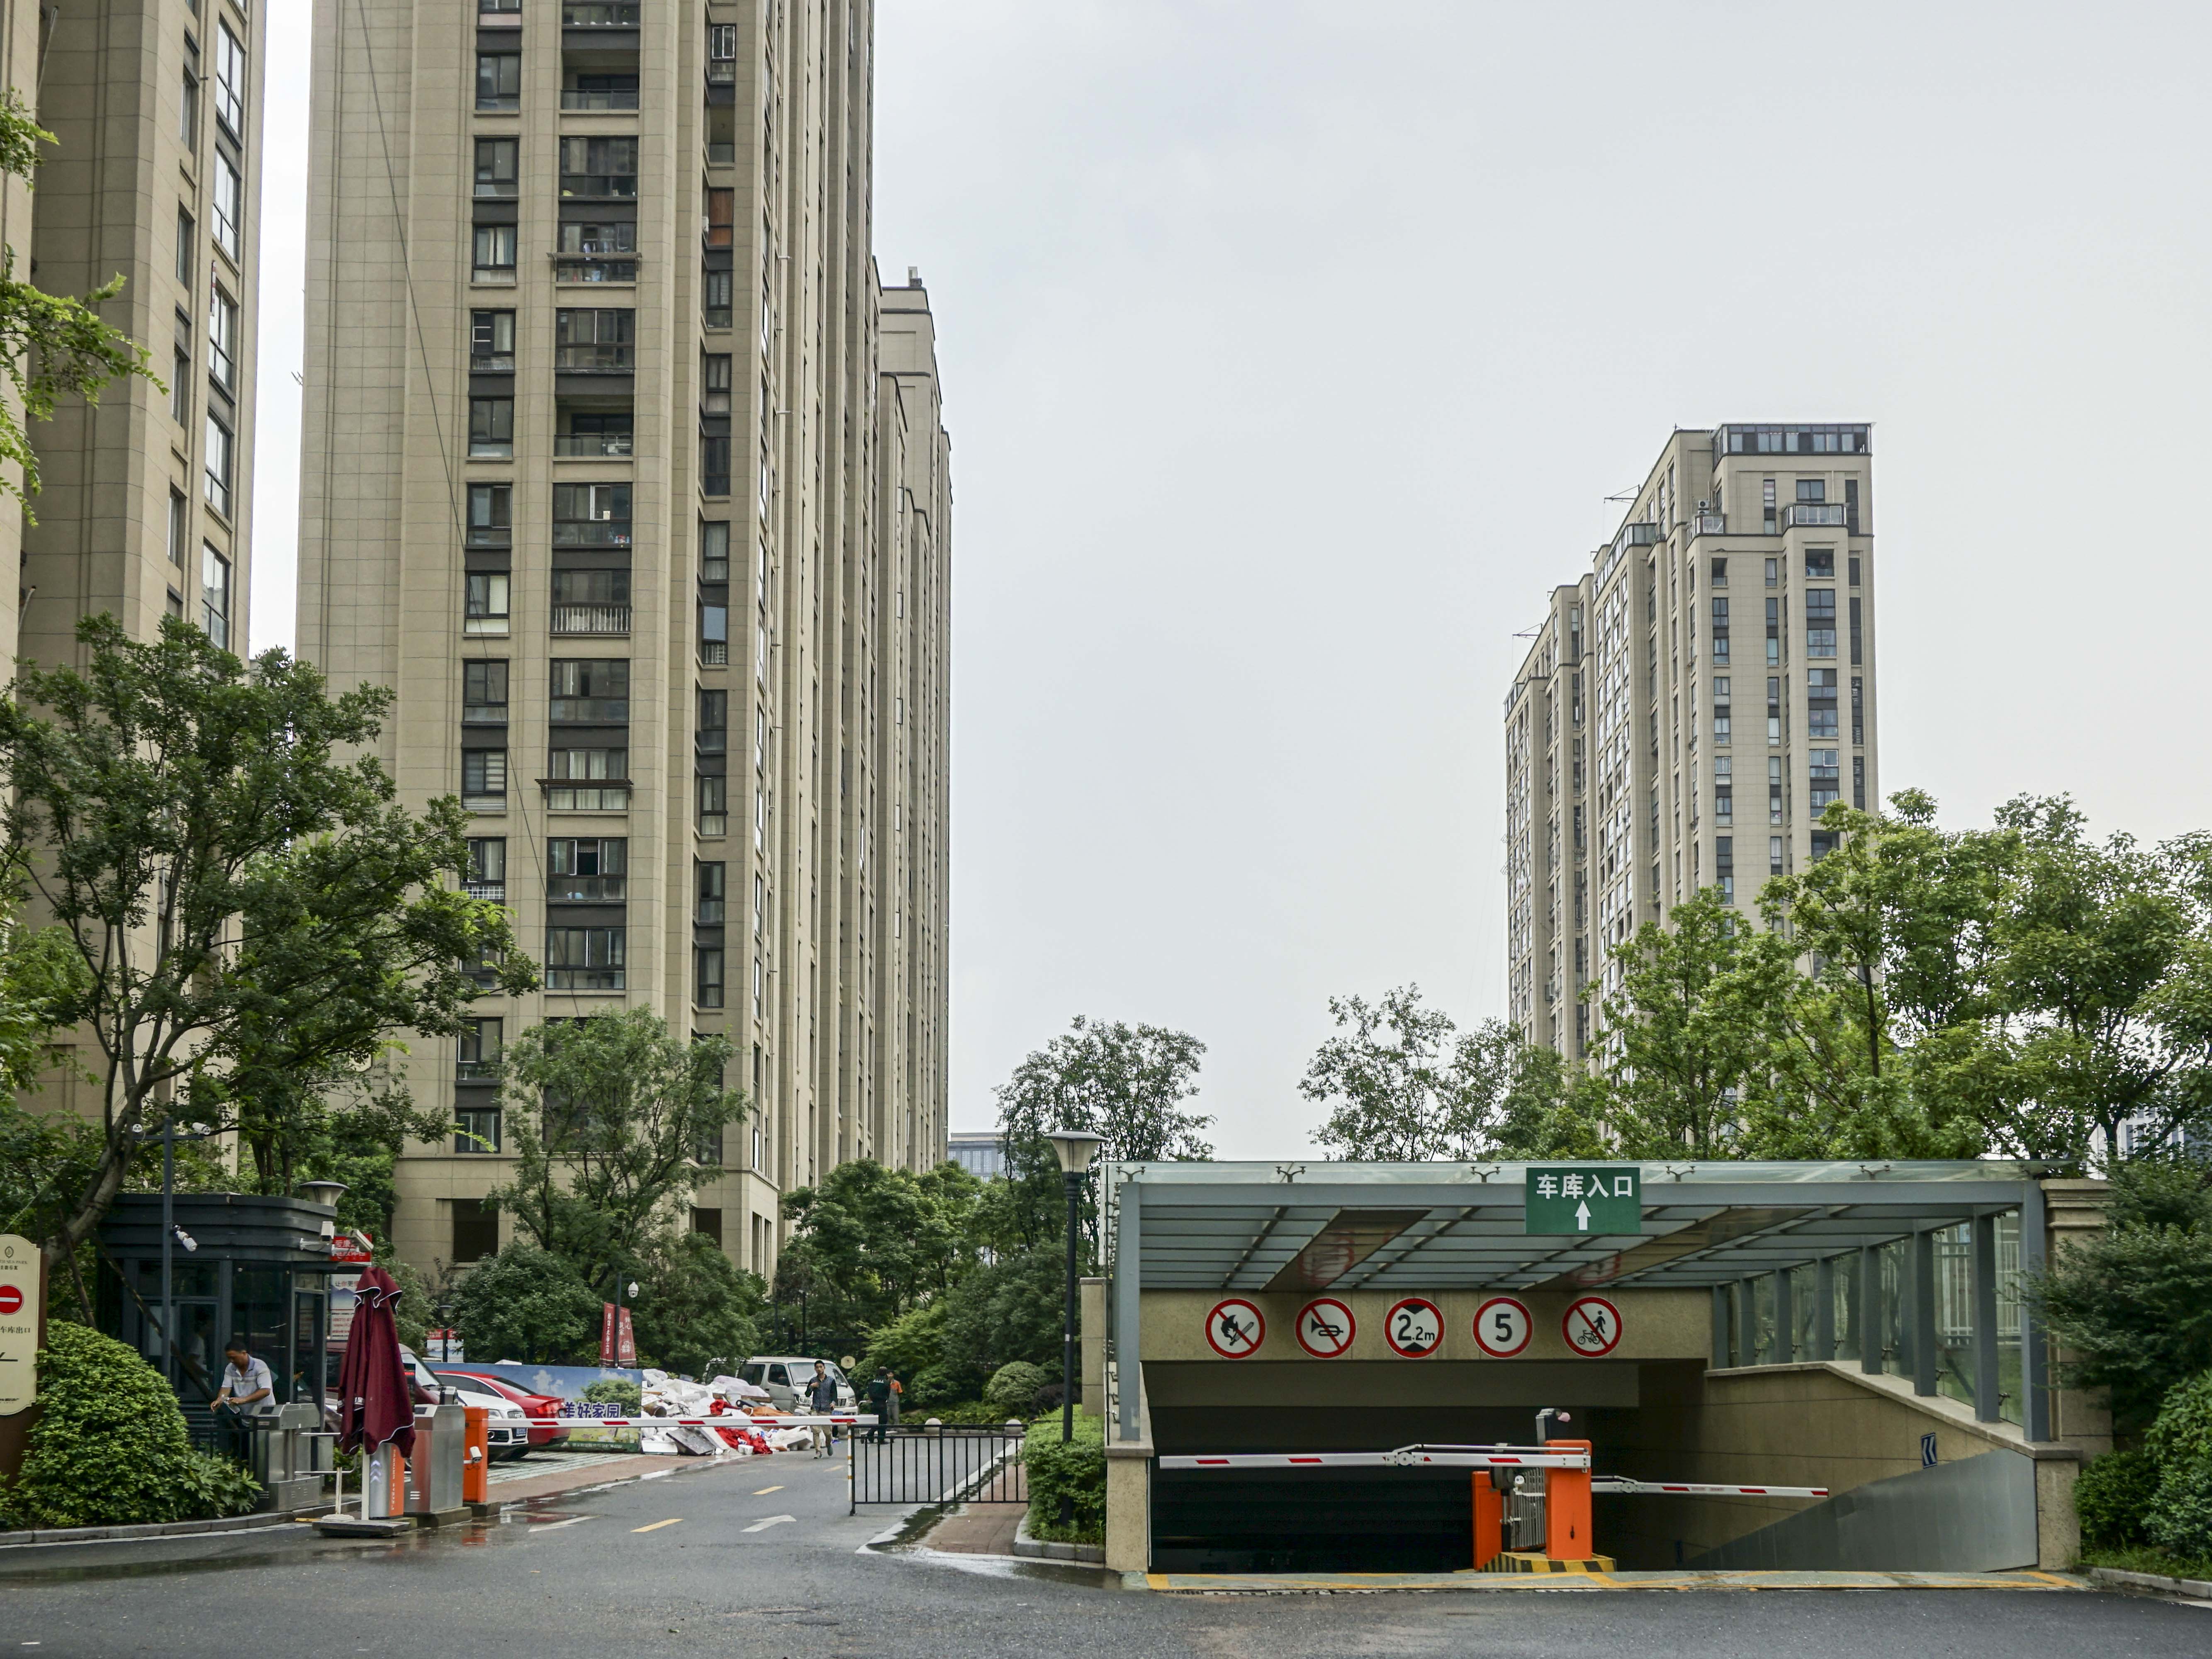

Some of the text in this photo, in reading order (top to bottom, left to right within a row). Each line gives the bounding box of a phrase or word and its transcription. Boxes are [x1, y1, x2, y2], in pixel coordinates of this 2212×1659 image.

[1536, 1173, 1632, 1199] 车库入口
[1397, 1314, 1435, 1340] 2.2m
[1496, 1314, 1512, 1342] 5
